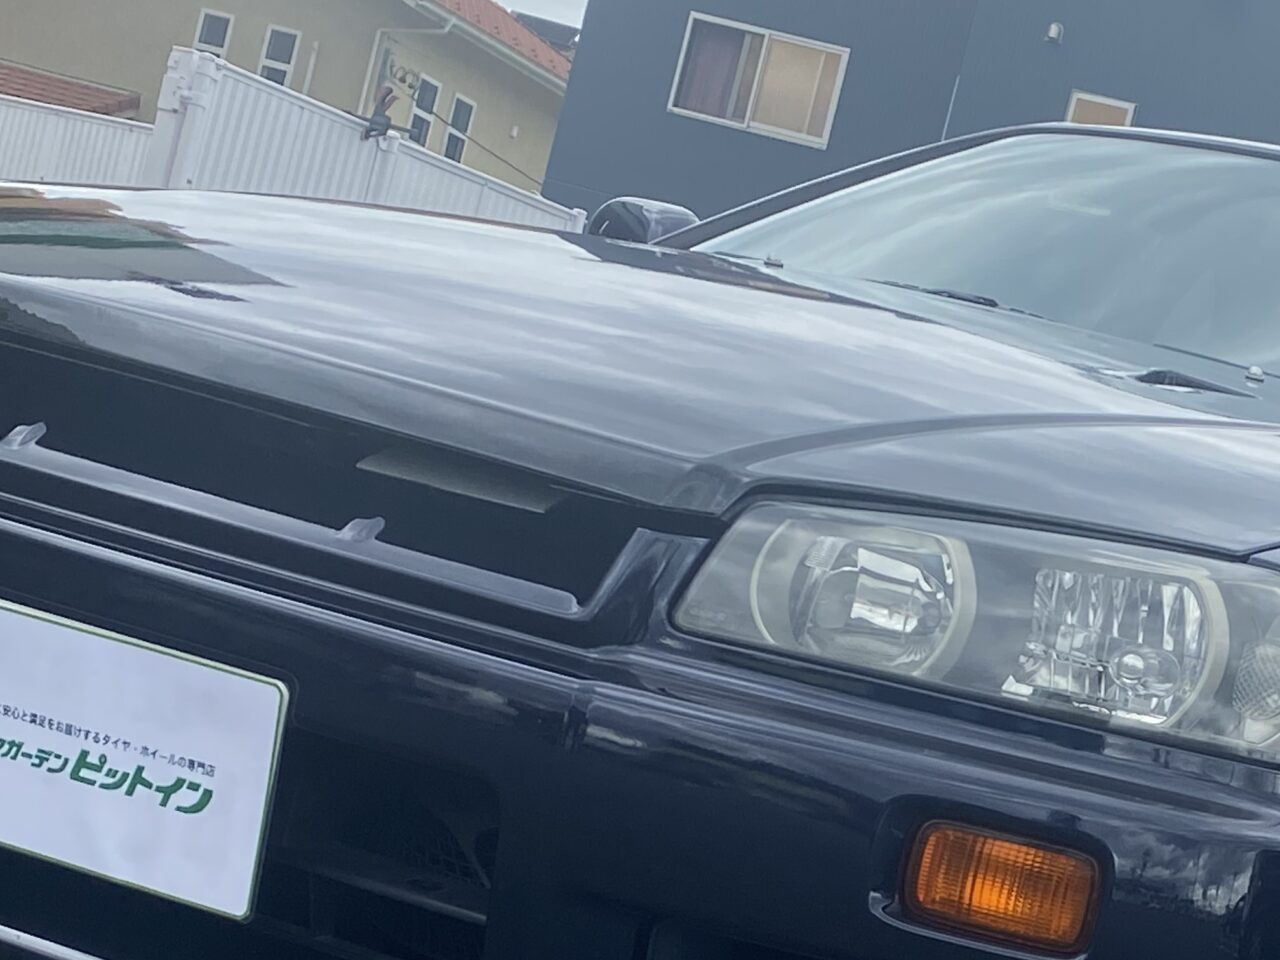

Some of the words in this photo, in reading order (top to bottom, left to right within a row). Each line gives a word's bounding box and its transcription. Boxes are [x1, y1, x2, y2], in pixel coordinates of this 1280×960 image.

[0, 704, 216, 777] 安心と満足をお届けするタイヤ・ホイールの専門店
